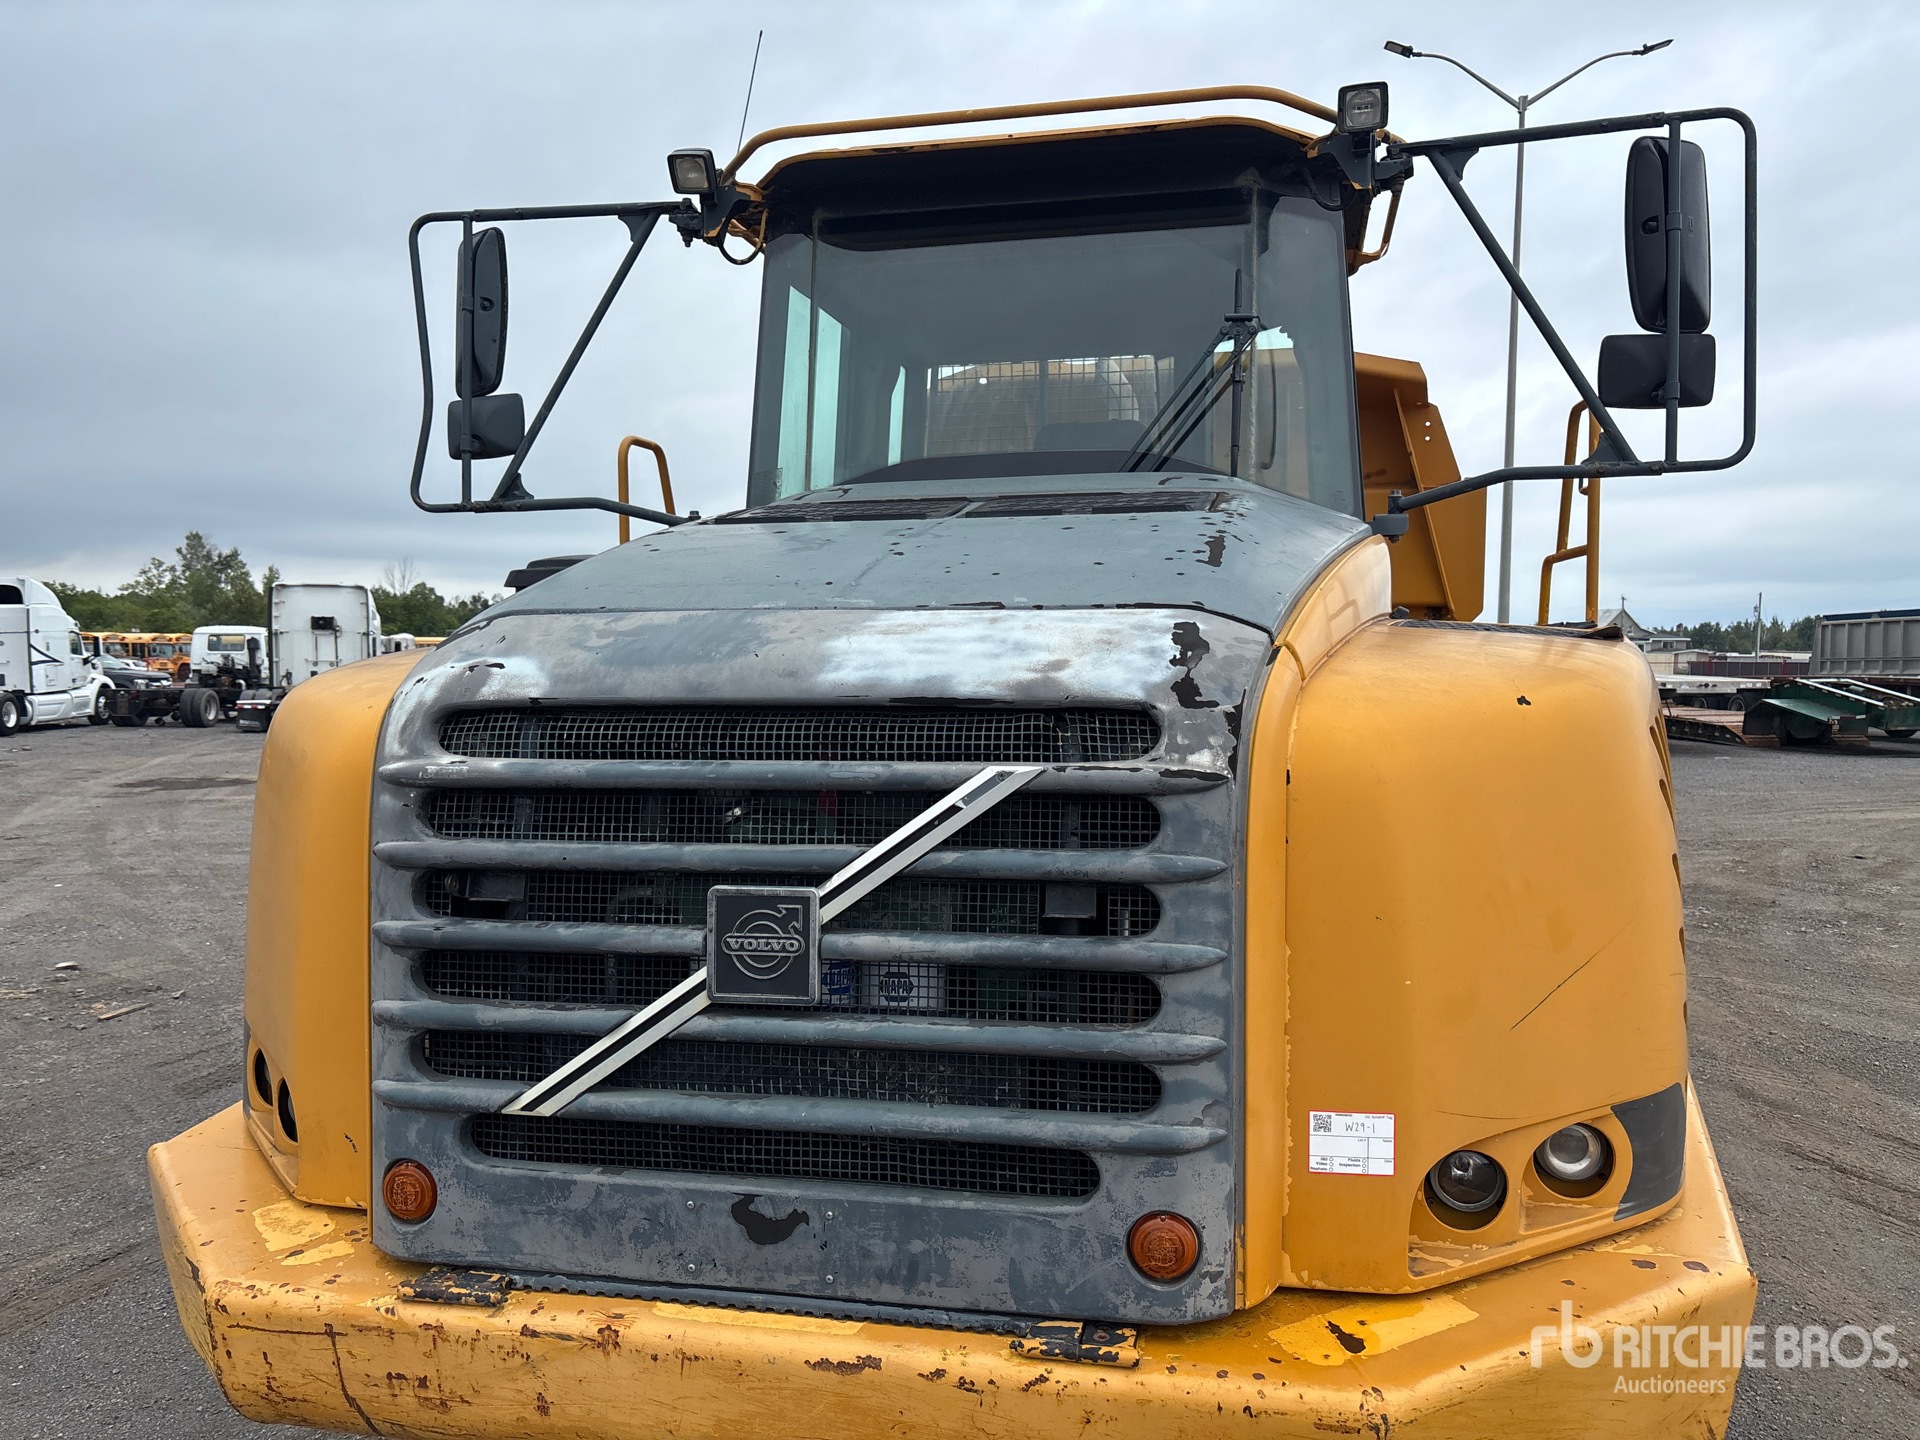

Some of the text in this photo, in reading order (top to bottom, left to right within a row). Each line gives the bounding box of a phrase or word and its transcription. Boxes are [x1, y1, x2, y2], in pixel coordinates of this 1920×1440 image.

[725, 937, 799, 951] VOLVO
[884, 979, 909, 995] NAPA
[1345, 1122, 1375, 1134] W29-1
